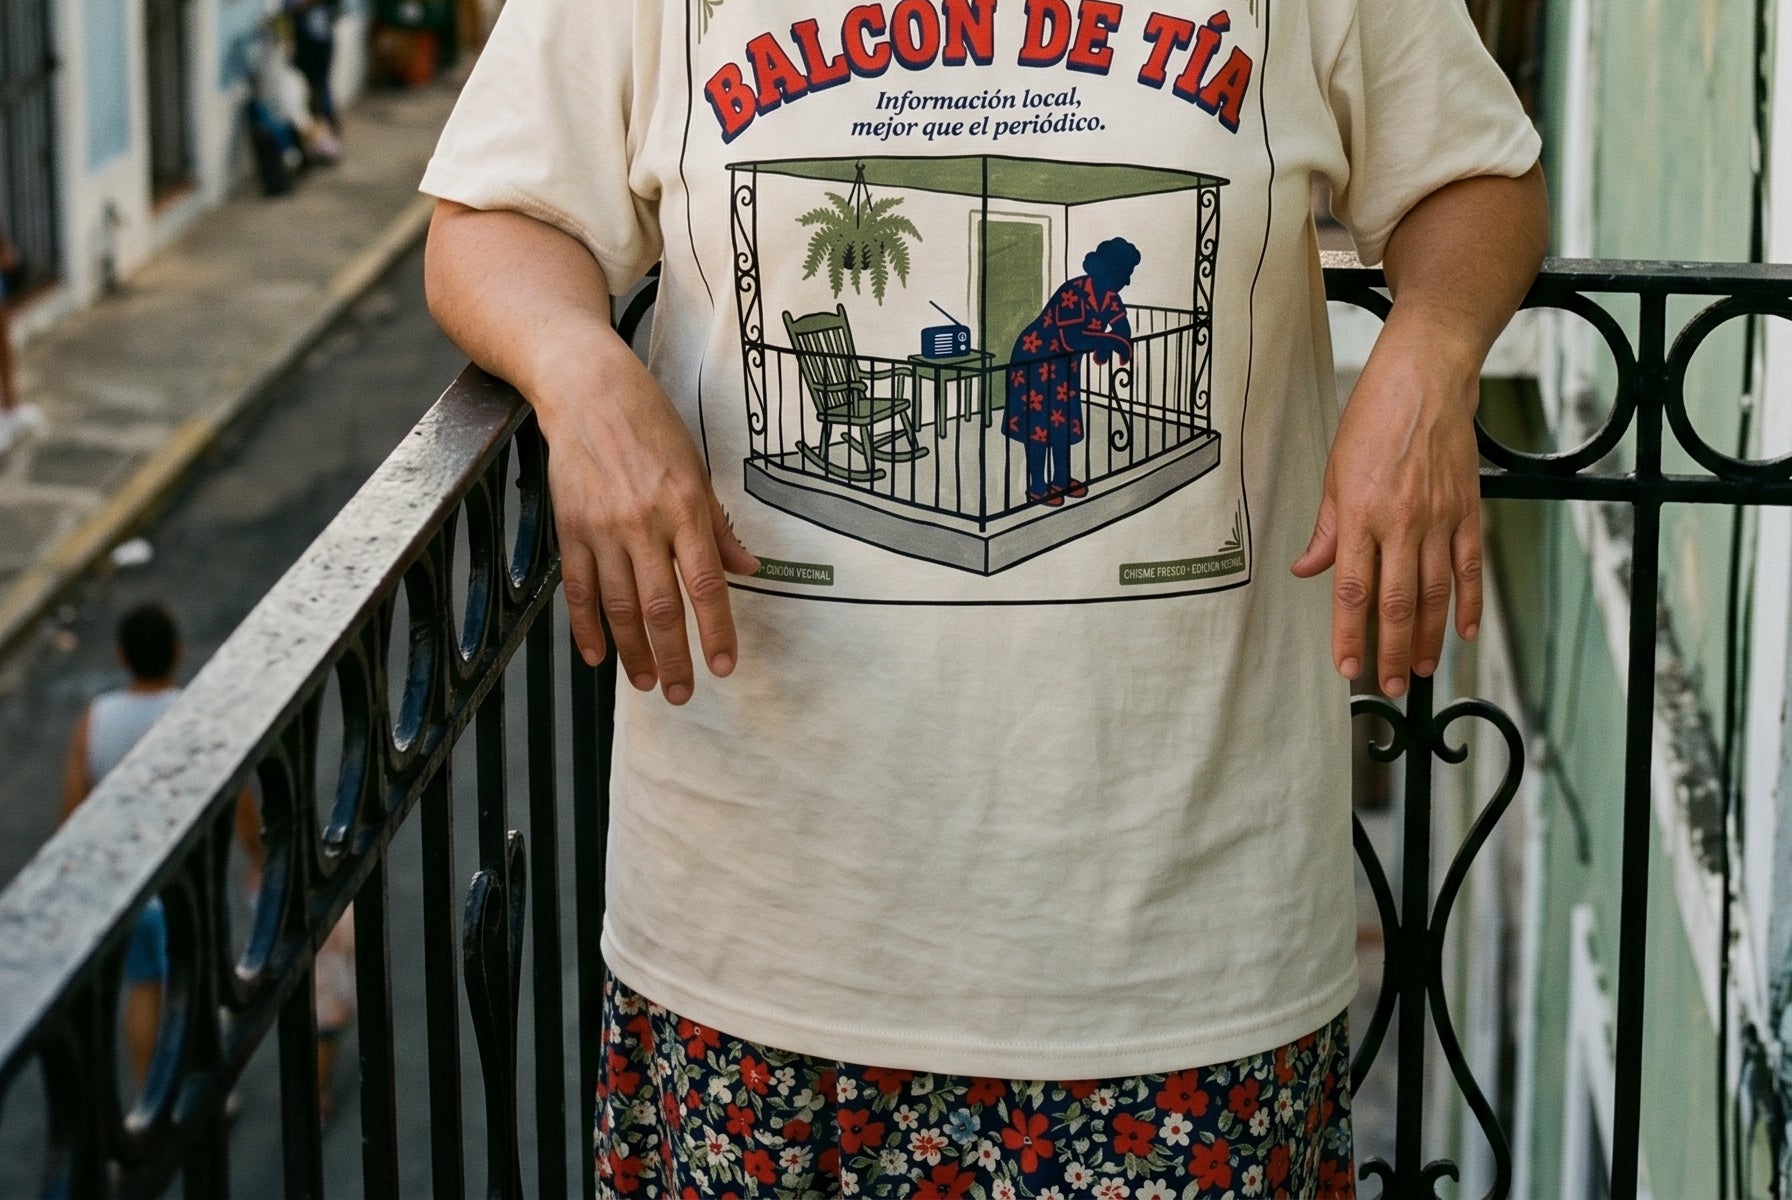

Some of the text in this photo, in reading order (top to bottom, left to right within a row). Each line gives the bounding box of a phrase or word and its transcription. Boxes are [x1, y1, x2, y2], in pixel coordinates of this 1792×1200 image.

[1138, 10, 1253, 135] TÍA
[876, 86, 1082, 116] Información local,
[851, 112, 1106, 142] mejor que el periódico.
[796, 568, 831, 580] VECINAL
[1123, 568, 1156, 580] CHISME
[1156, 565, 1186, 578] FRESCO
